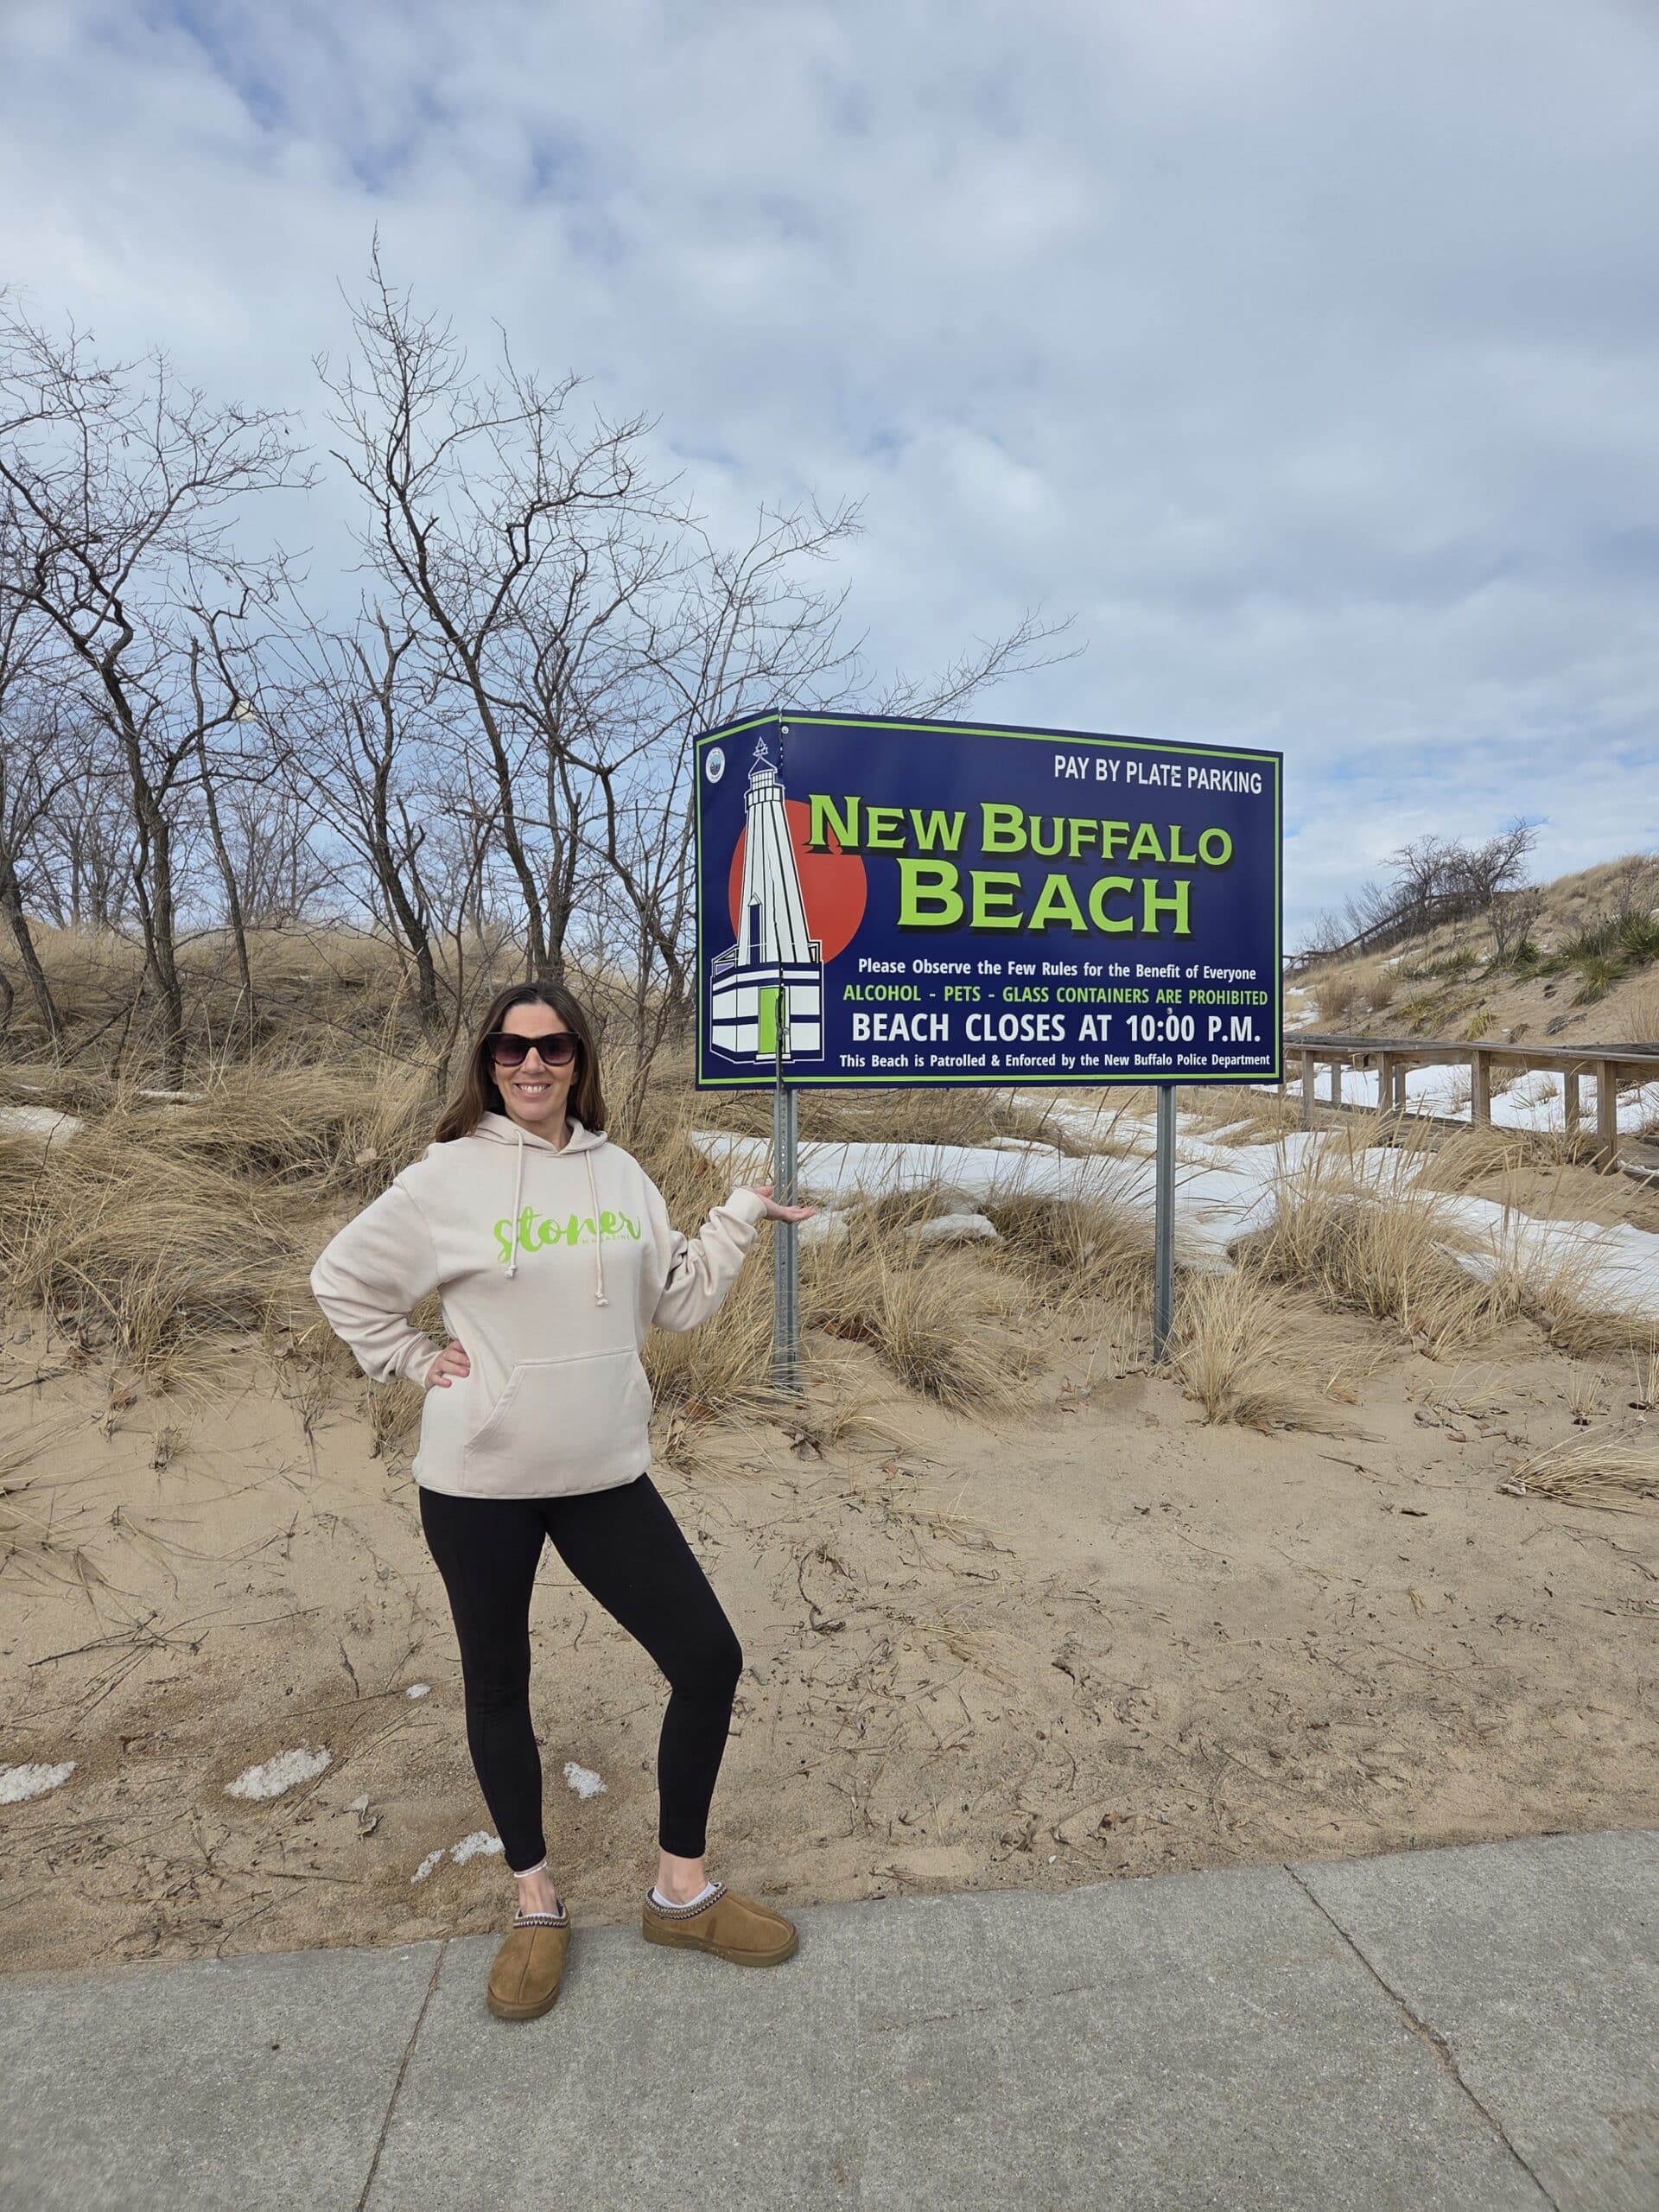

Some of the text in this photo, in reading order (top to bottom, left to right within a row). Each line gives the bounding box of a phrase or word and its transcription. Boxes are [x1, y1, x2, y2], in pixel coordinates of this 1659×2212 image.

[1054, 754, 1262, 795] PAY BY PLATE PARKING
[808, 794, 1232, 866] NEW BUFFALO
[895, 858, 1192, 934] BEACH
[858, 957, 1256, 983] Please Observe the Few Rules for the Benefit of Everyone
[842, 984, 922, 1001] ALCOHOL
[944, 985, 982, 1002] PETS
[1002, 986, 1049, 1003] GLASS
[1056, 987, 1149, 1004] CONTAINERS
[1155, 988, 1182, 1004] ARE
[1189, 989, 1268, 1006] PROHIBITED
[852, 1013, 1261, 1042] BEACH CLOSES AT 10:00 P.M.
[839, 1052, 1270, 1070] This Beach is Patrolled & Enforced by the New Buffalo Police Department
[493, 1206, 641, 1263] stoner
